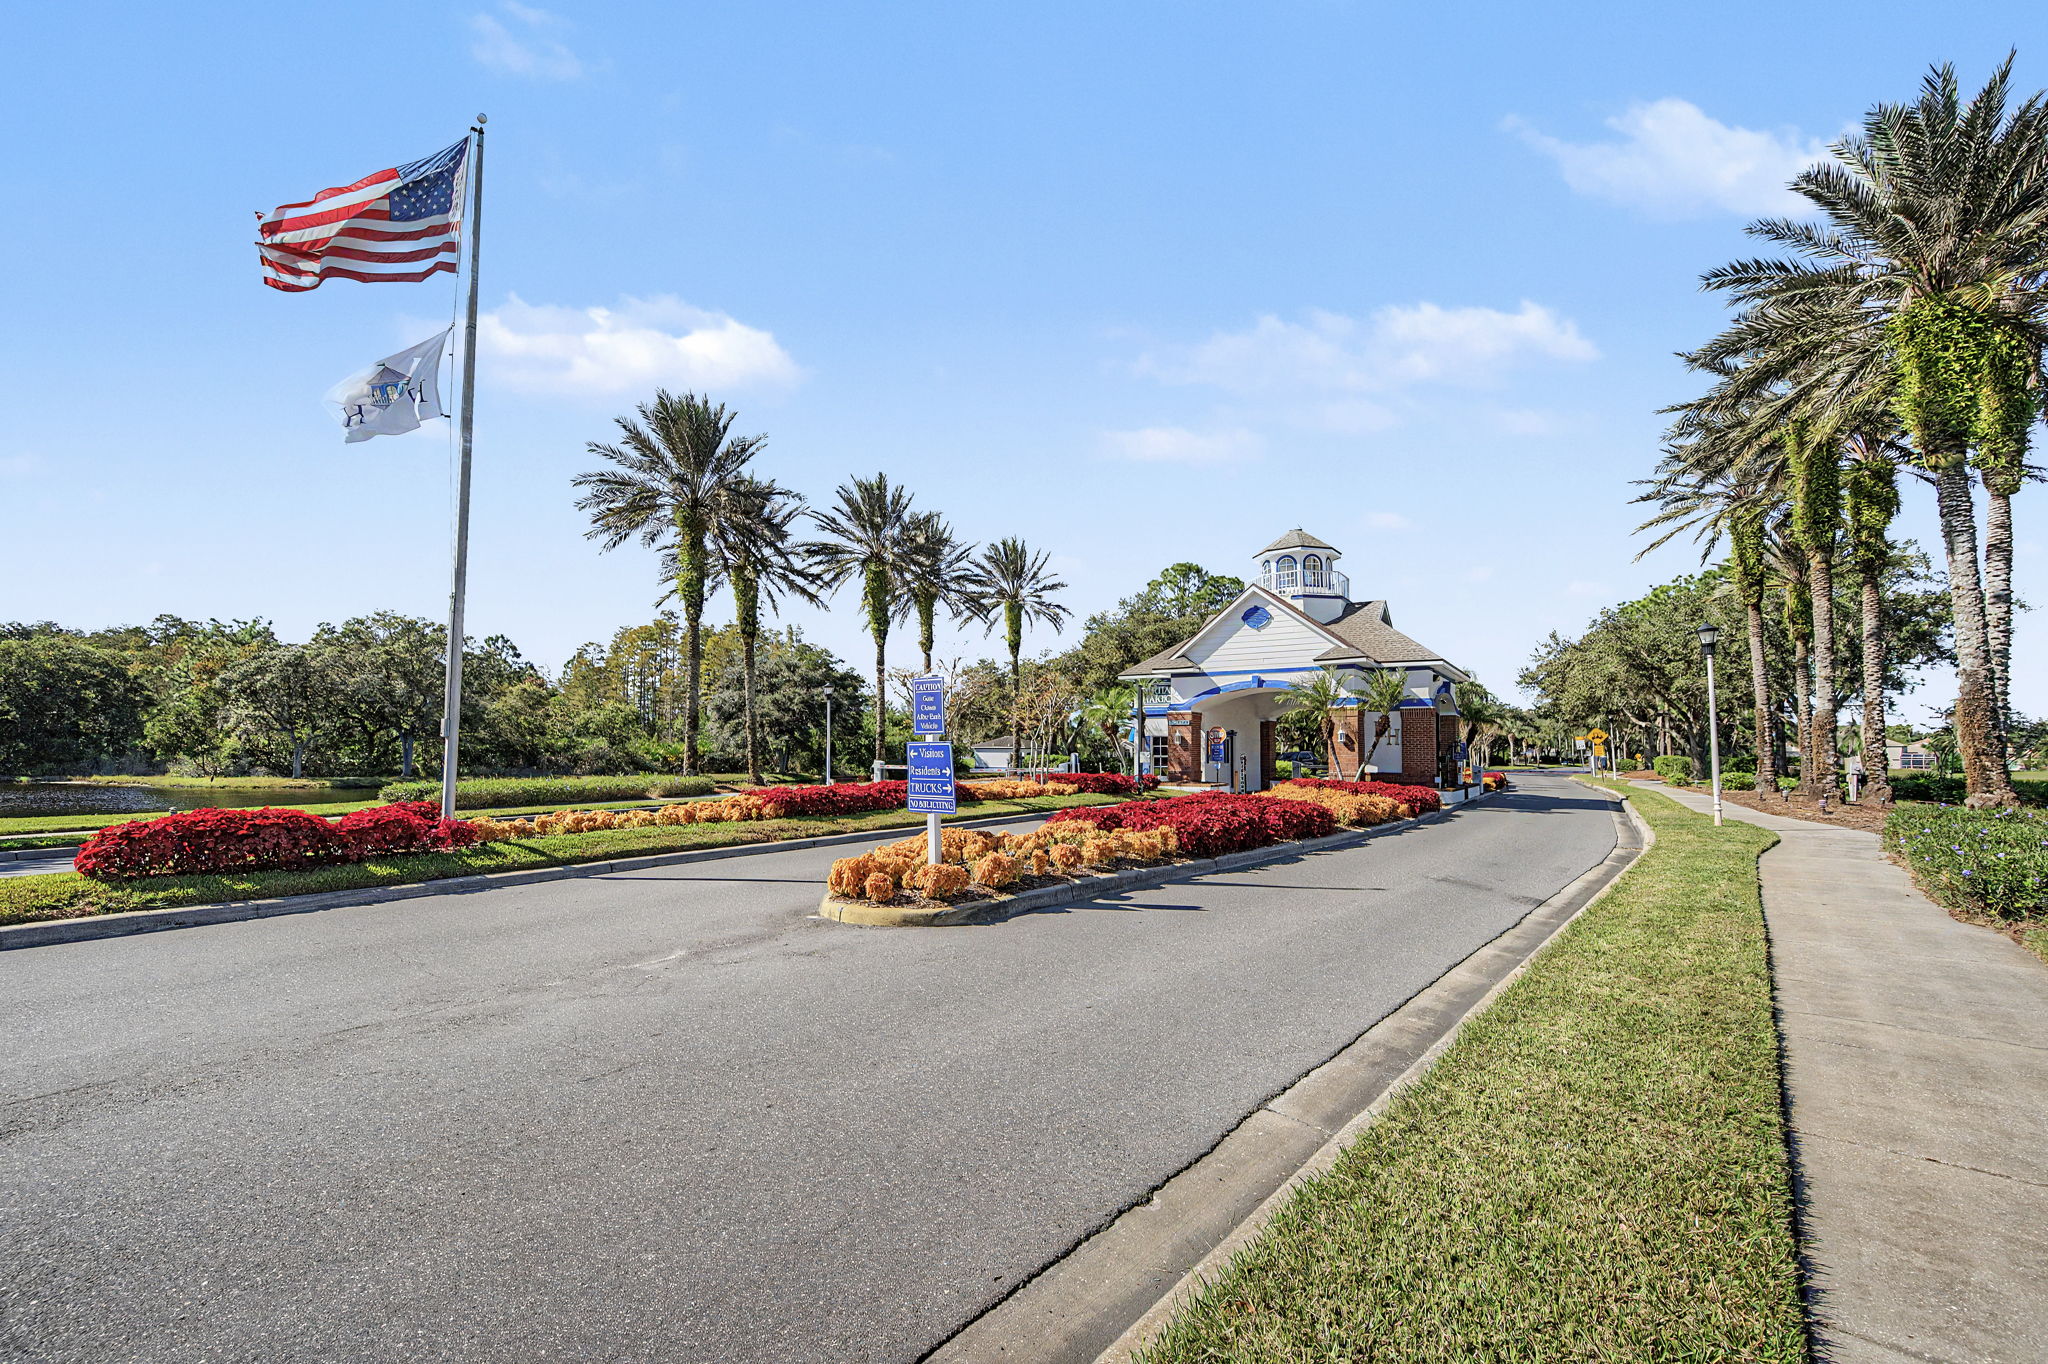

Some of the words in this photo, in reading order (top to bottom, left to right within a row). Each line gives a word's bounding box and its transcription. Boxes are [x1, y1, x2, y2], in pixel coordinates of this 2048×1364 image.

[915, 683, 941, 691] CAUTION
[919, 747, 944, 758] Visitors
[910, 765, 941, 776] Residents
[910, 782, 943, 794] TRUCKS
[910, 799, 919, 808] NO
[919, 800, 954, 810] SOLICITING
